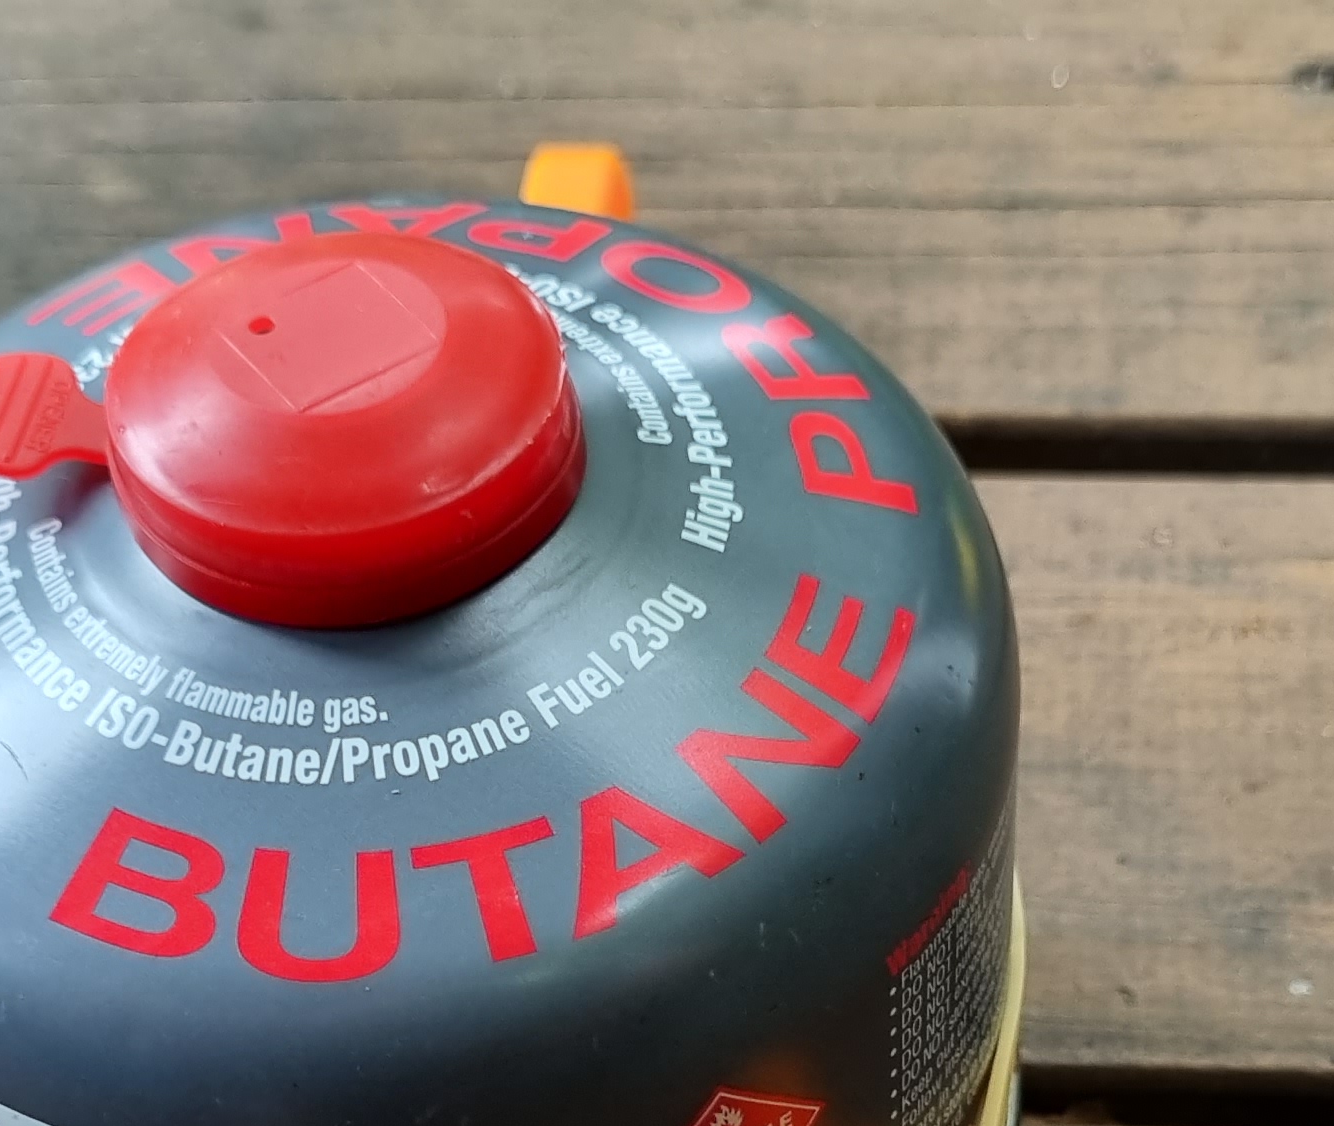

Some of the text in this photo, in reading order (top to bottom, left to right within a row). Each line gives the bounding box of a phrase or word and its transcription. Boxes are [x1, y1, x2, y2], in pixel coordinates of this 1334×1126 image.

[610, 362, 673, 446] Contains
[28, 517, 389, 734] Contains extremely flammable gas.
[84, 687, 531, 785] ISO-Butane/Propane
[526, 651, 625, 730] Fuel
[609, 582, 708, 671] 230g
[49, 573, 917, 983] BUTANE
[901, 970, 922, 1010] DO
[927, 928, 952, 981] NOT
[901, 990, 922, 1030] DO
[927, 949, 952, 1001] NOT
[901, 1011, 921, 1051] DO
[926, 970, 952, 1022] NOT
[901, 1032, 921, 1072] DO
[926, 990, 951, 1043] NOT
[901, 1054, 920, 1093] DO
[923, 1019, 946, 1067] NOT
[902, 1060, 932, 1116] Keep
